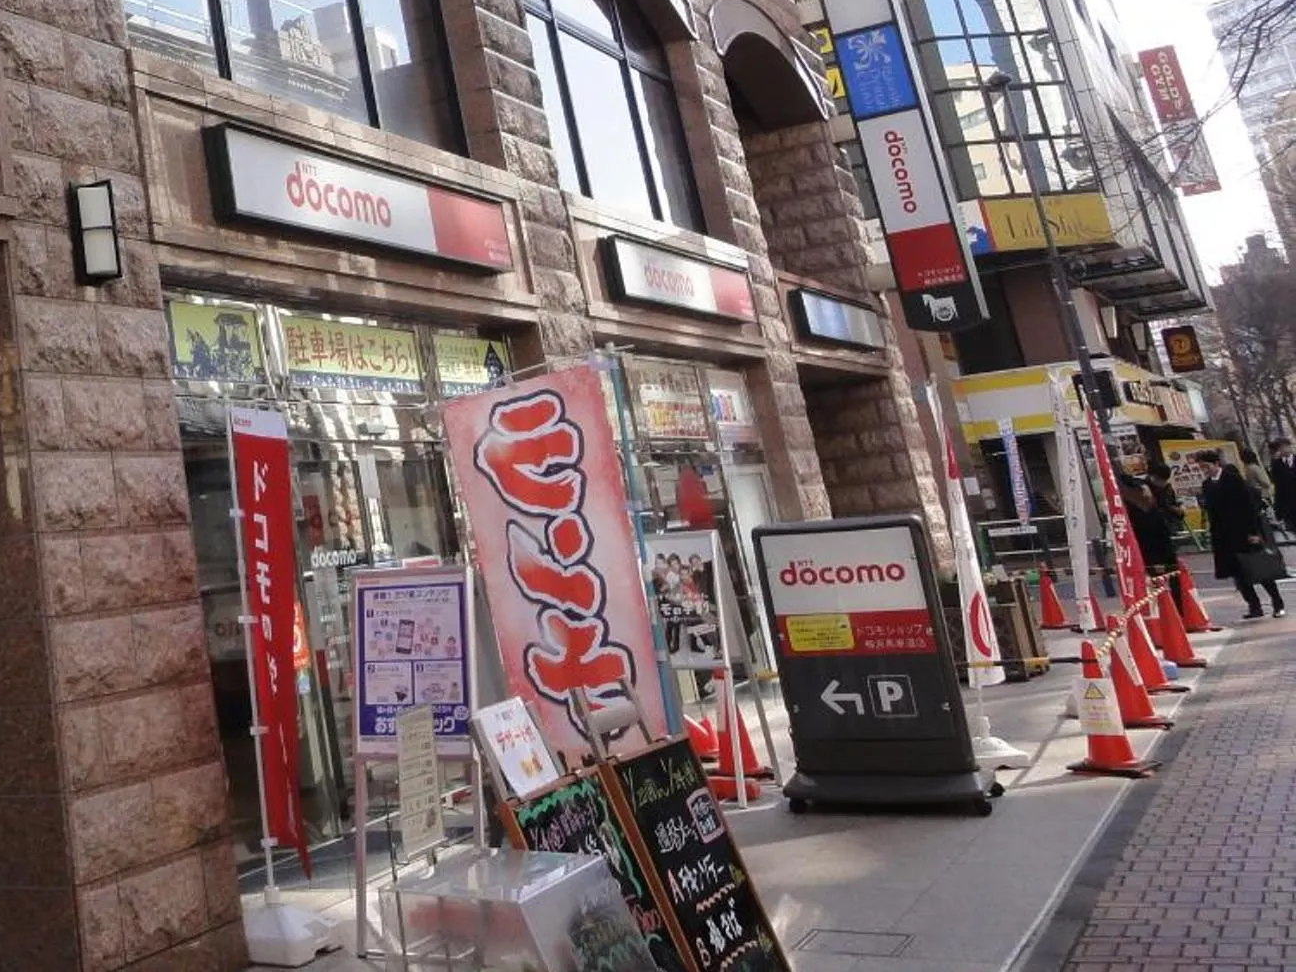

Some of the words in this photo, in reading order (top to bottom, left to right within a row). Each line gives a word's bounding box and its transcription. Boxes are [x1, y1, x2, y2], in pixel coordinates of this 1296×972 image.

[884, 129, 917, 215] docomo
[286, 160, 392, 227] docomo
[310, 545, 357, 568] docomo
[779, 561, 906, 586] docomo
[877, 681, 903, 712] P
